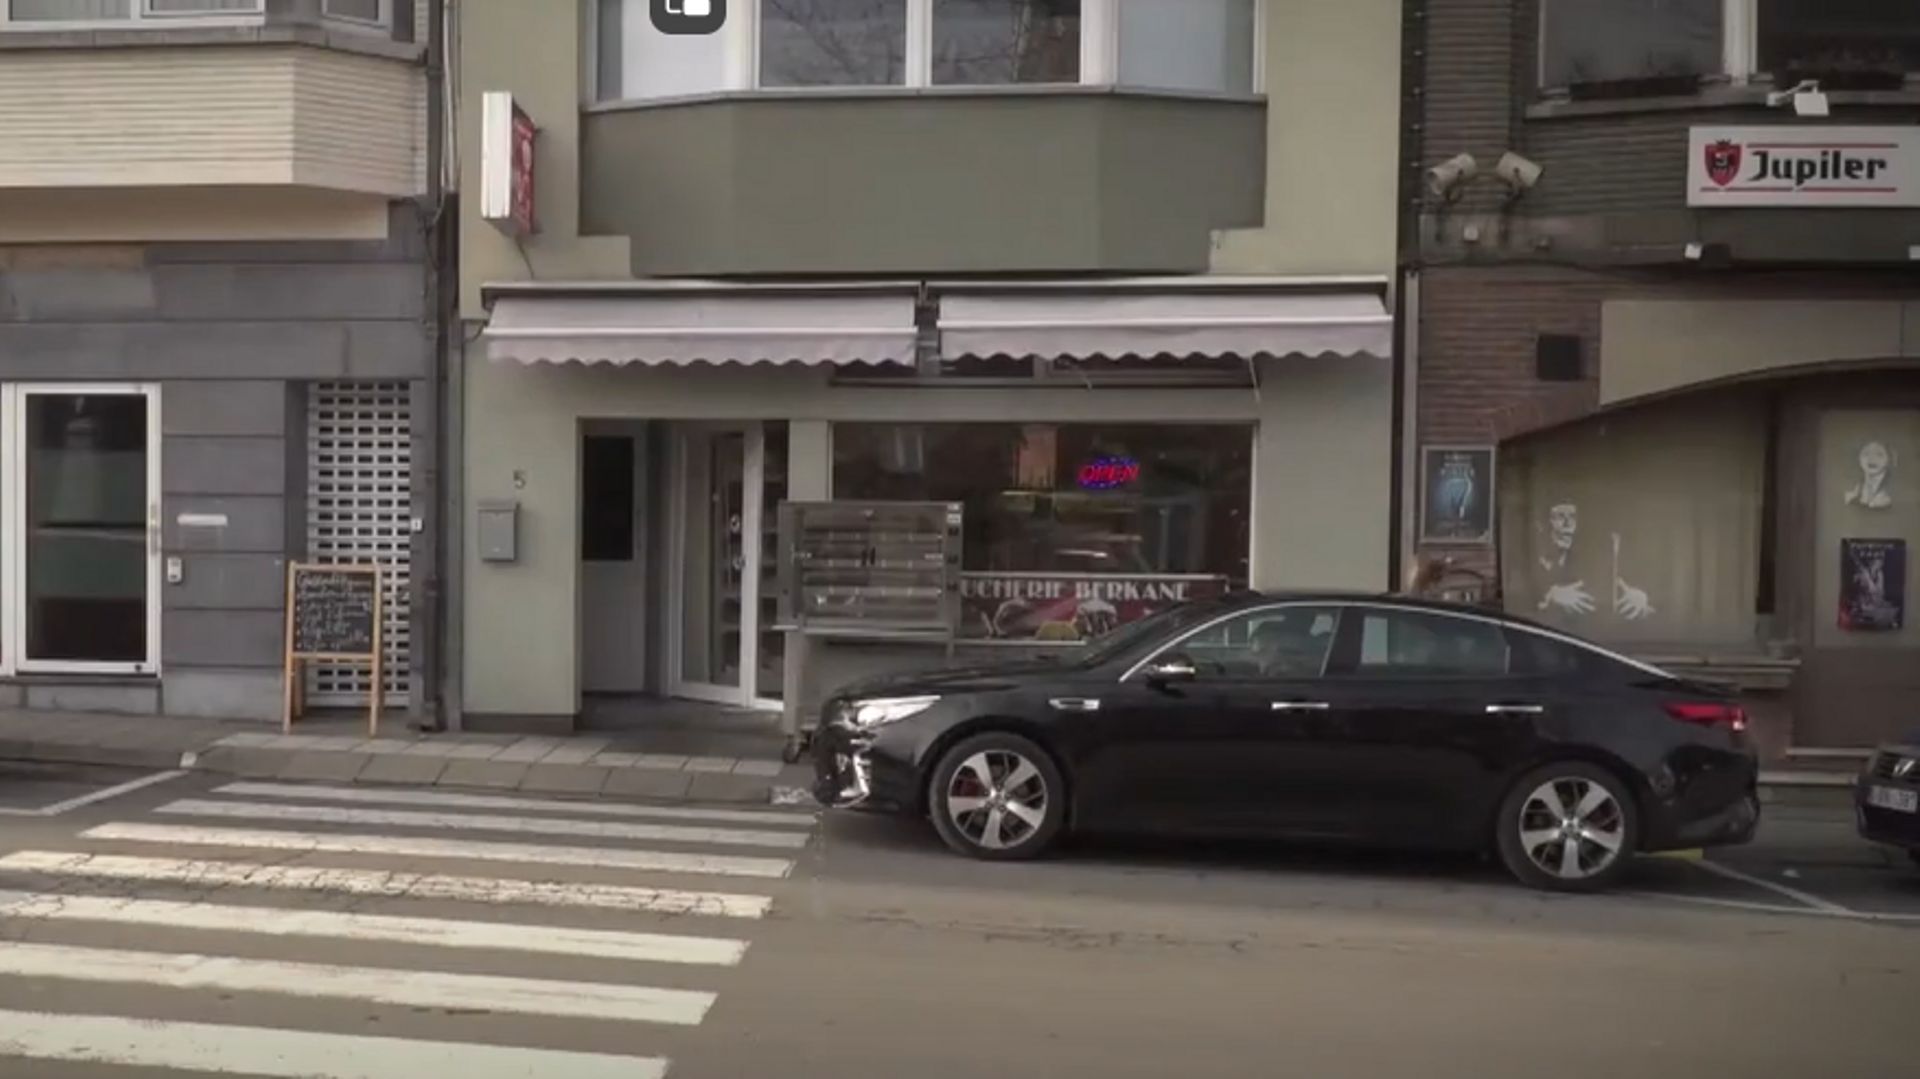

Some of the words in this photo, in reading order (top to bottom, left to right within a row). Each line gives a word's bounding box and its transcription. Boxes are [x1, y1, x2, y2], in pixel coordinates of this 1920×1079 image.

[1747, 150, 1887, 186] Jupiler
[513, 470, 526, 490] 5
[1077, 464, 1141, 482] OPEN
[1075, 581, 1191, 602] BERKANE
